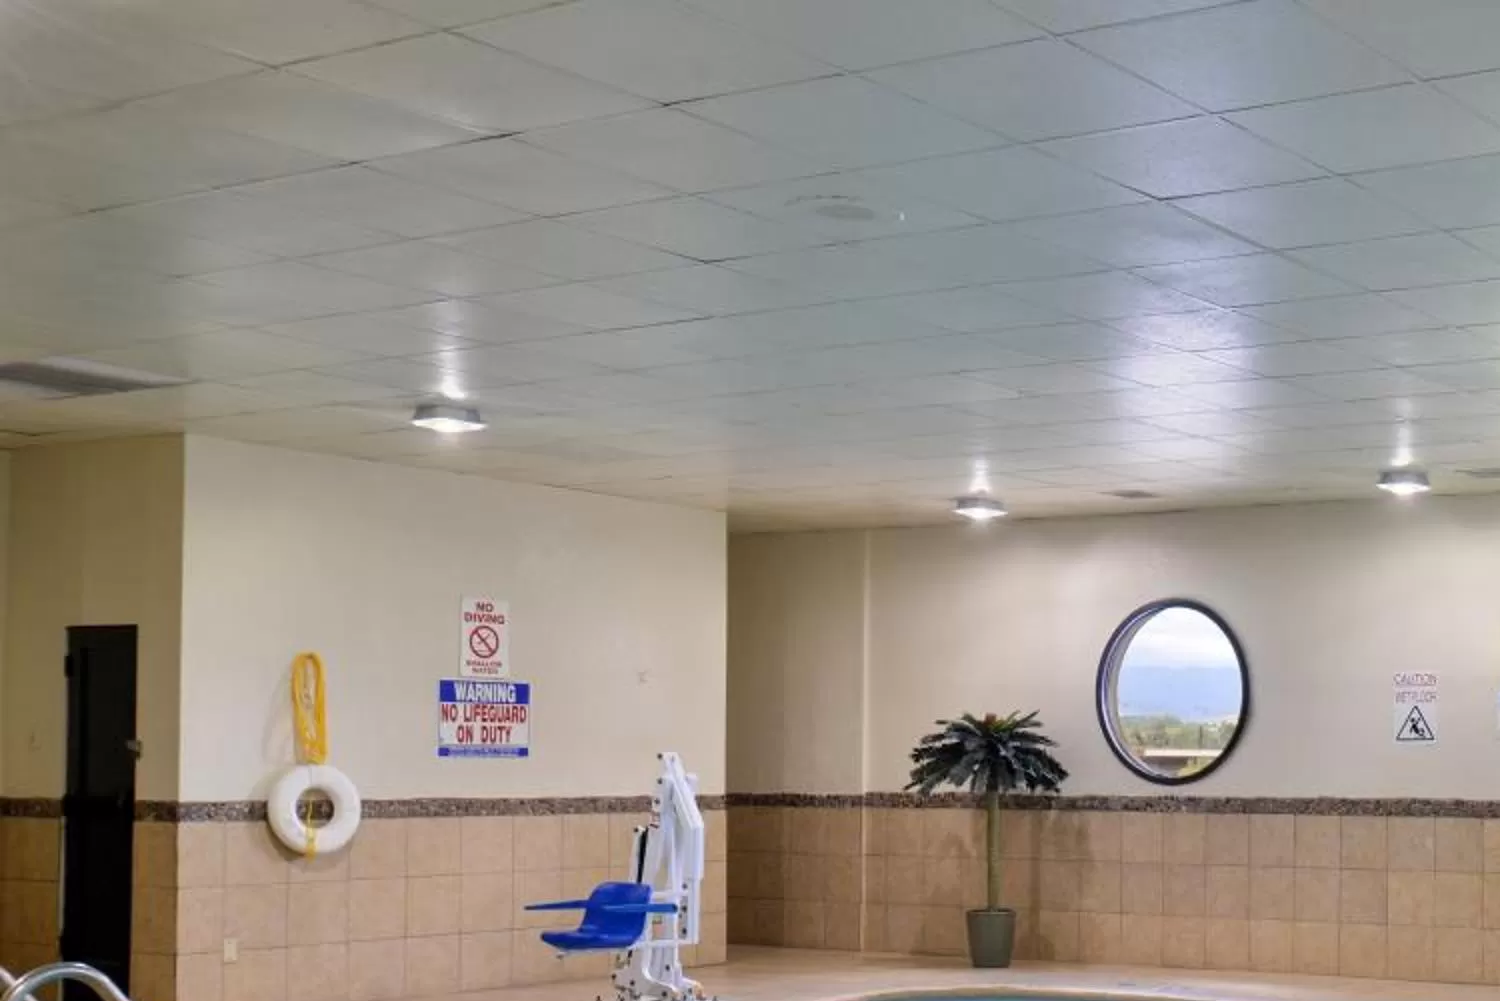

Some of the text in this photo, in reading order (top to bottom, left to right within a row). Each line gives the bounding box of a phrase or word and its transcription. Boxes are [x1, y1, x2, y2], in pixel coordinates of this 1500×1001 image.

[475, 602, 494, 612] NO
[464, 612, 504, 624] DIVING
[1392, 673, 1437, 686] CAUTION
[454, 682, 517, 702] WARNING
[441, 704, 527, 722] NO LIFEGUARD
[456, 725, 512, 743] ON DUTY
